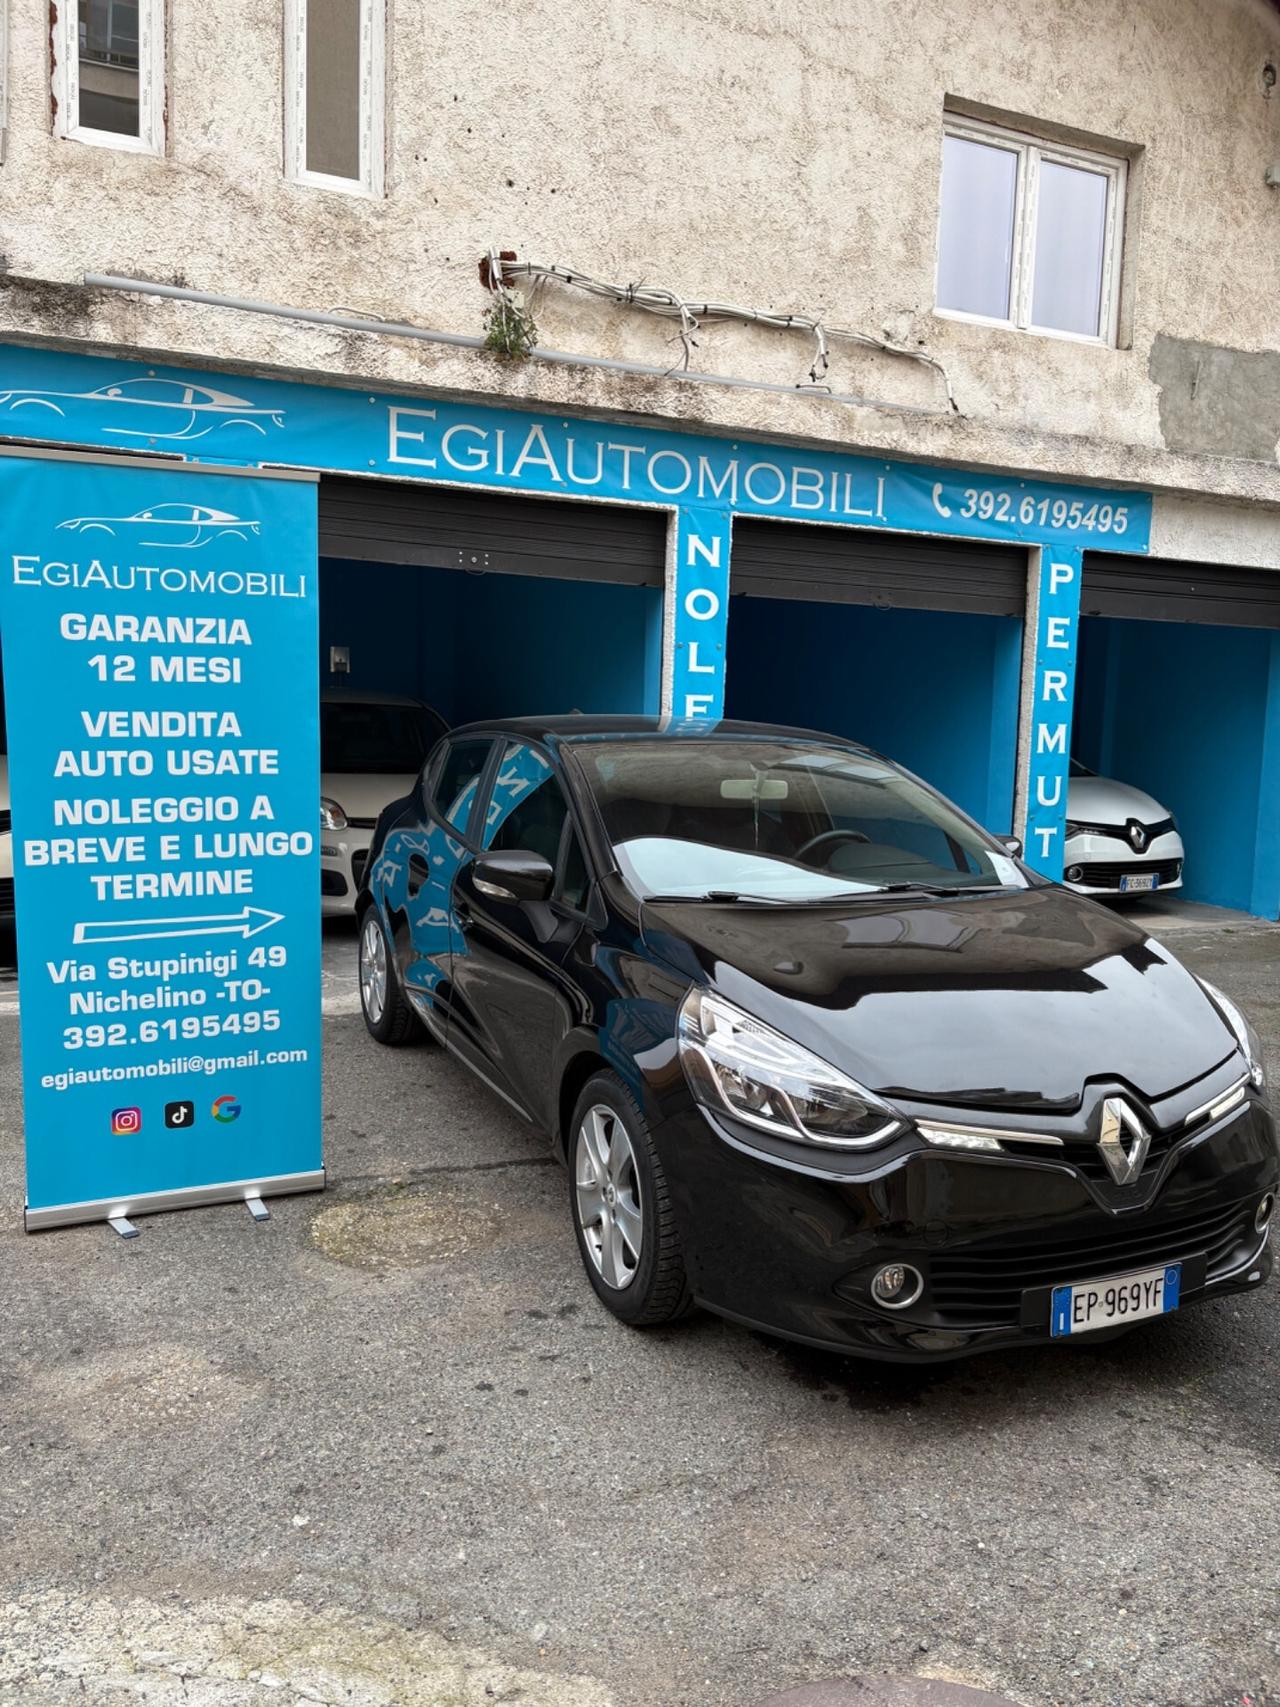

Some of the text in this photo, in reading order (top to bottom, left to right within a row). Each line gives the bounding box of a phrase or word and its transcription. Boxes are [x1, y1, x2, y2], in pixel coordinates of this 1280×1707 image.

[960, 489, 1129, 535] 392.6195495
[60, 613, 252, 645] GARANZIA
[88, 654, 241, 683] 12 MESI
[81, 711, 242, 738] VENDITA
[54, 750, 279, 777] AUTO USATE
[54, 795, 274, 826] NOLEGGIO A
[24, 831, 313, 867] BREVE E LUNGO
[90, 869, 253, 901] TERMINE
[47, 945, 287, 984] Via Stupinigi 49
[70, 979, 271, 1015] Nichelino -TO-
[63, 1009, 281, 1050] 392.6195495
[41, 1048, 308, 1091] egiautomobili@gmail.com
[1073, 1293, 1099, 1324] EP
[1105, 1278, 1164, 1318] 969YF
